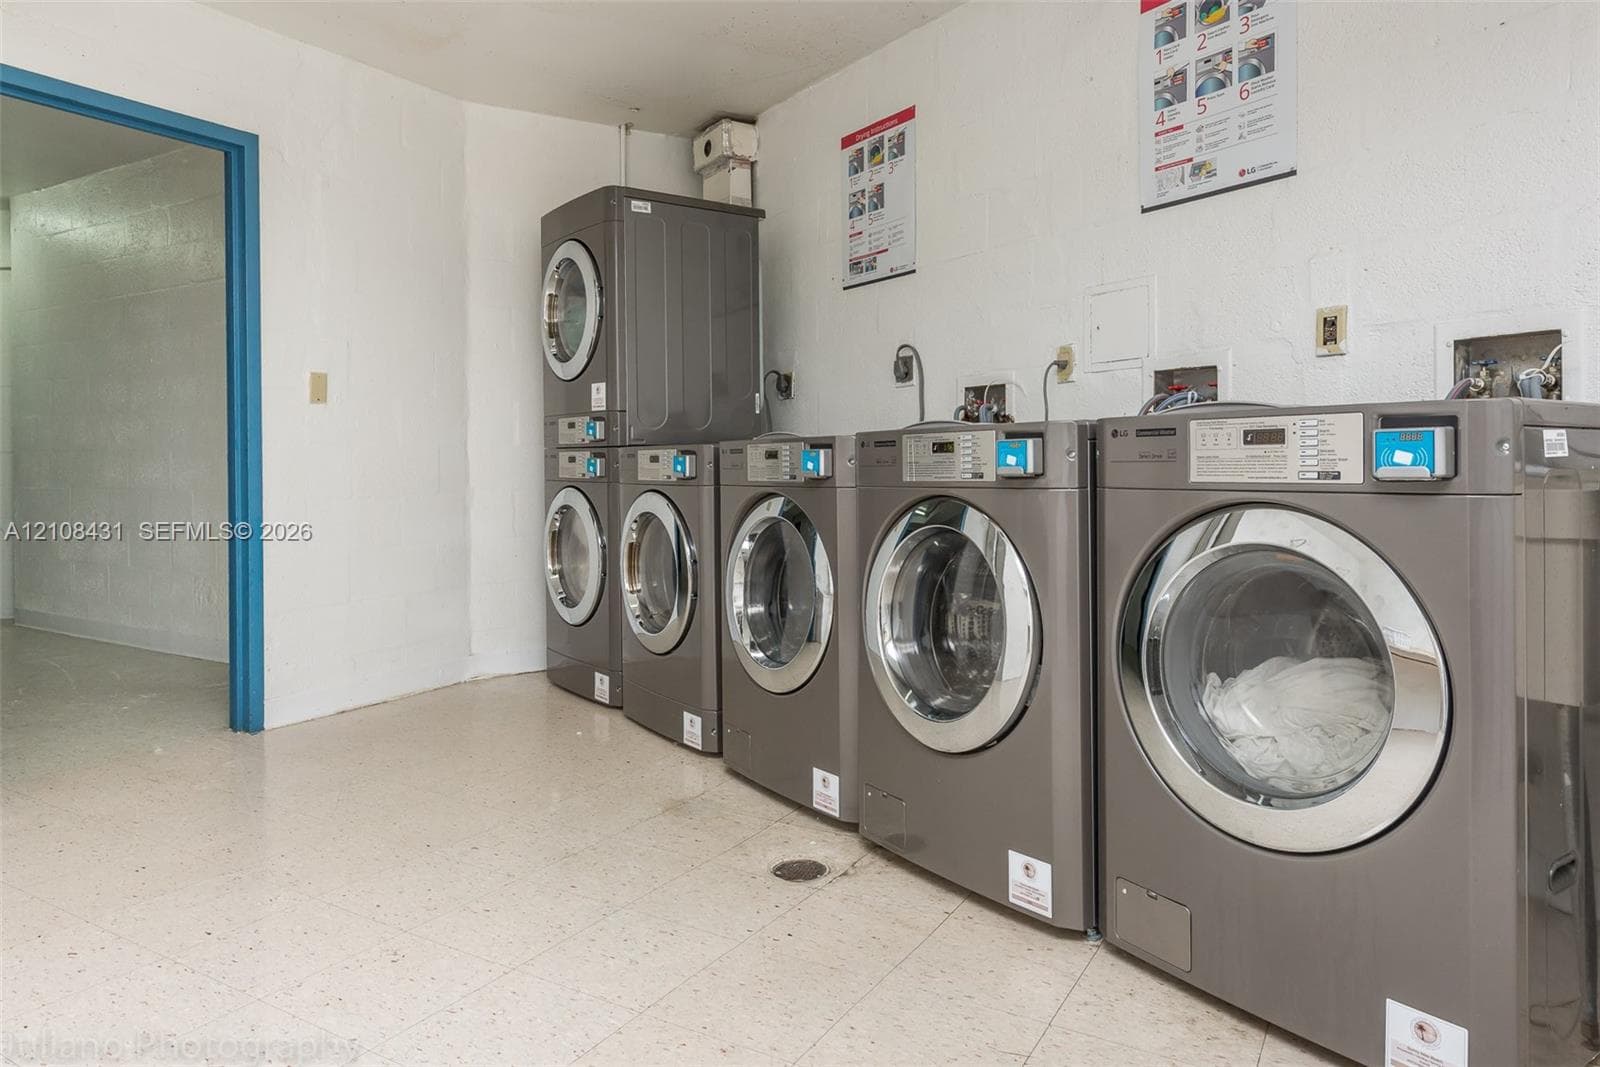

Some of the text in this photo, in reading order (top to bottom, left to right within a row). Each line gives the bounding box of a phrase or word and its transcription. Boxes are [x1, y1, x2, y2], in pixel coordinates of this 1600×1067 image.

[1240, 16, 1250, 34] 3
[1197, 33, 1207, 51] 2
[1156, 49, 1162, 65] 1
[1240, 82, 1250, 101] 6
[1197, 97, 1207, 115] 5
[1155, 111, 1166, 126] 4
[888, 161, 894, 175] 3
[1247, 166, 1256, 175] LG
[868, 170, 874, 182] 2
[849, 219, 855, 231] 4
[868, 213, 874, 226] 5
[1119, 430, 1129, 438] LG
